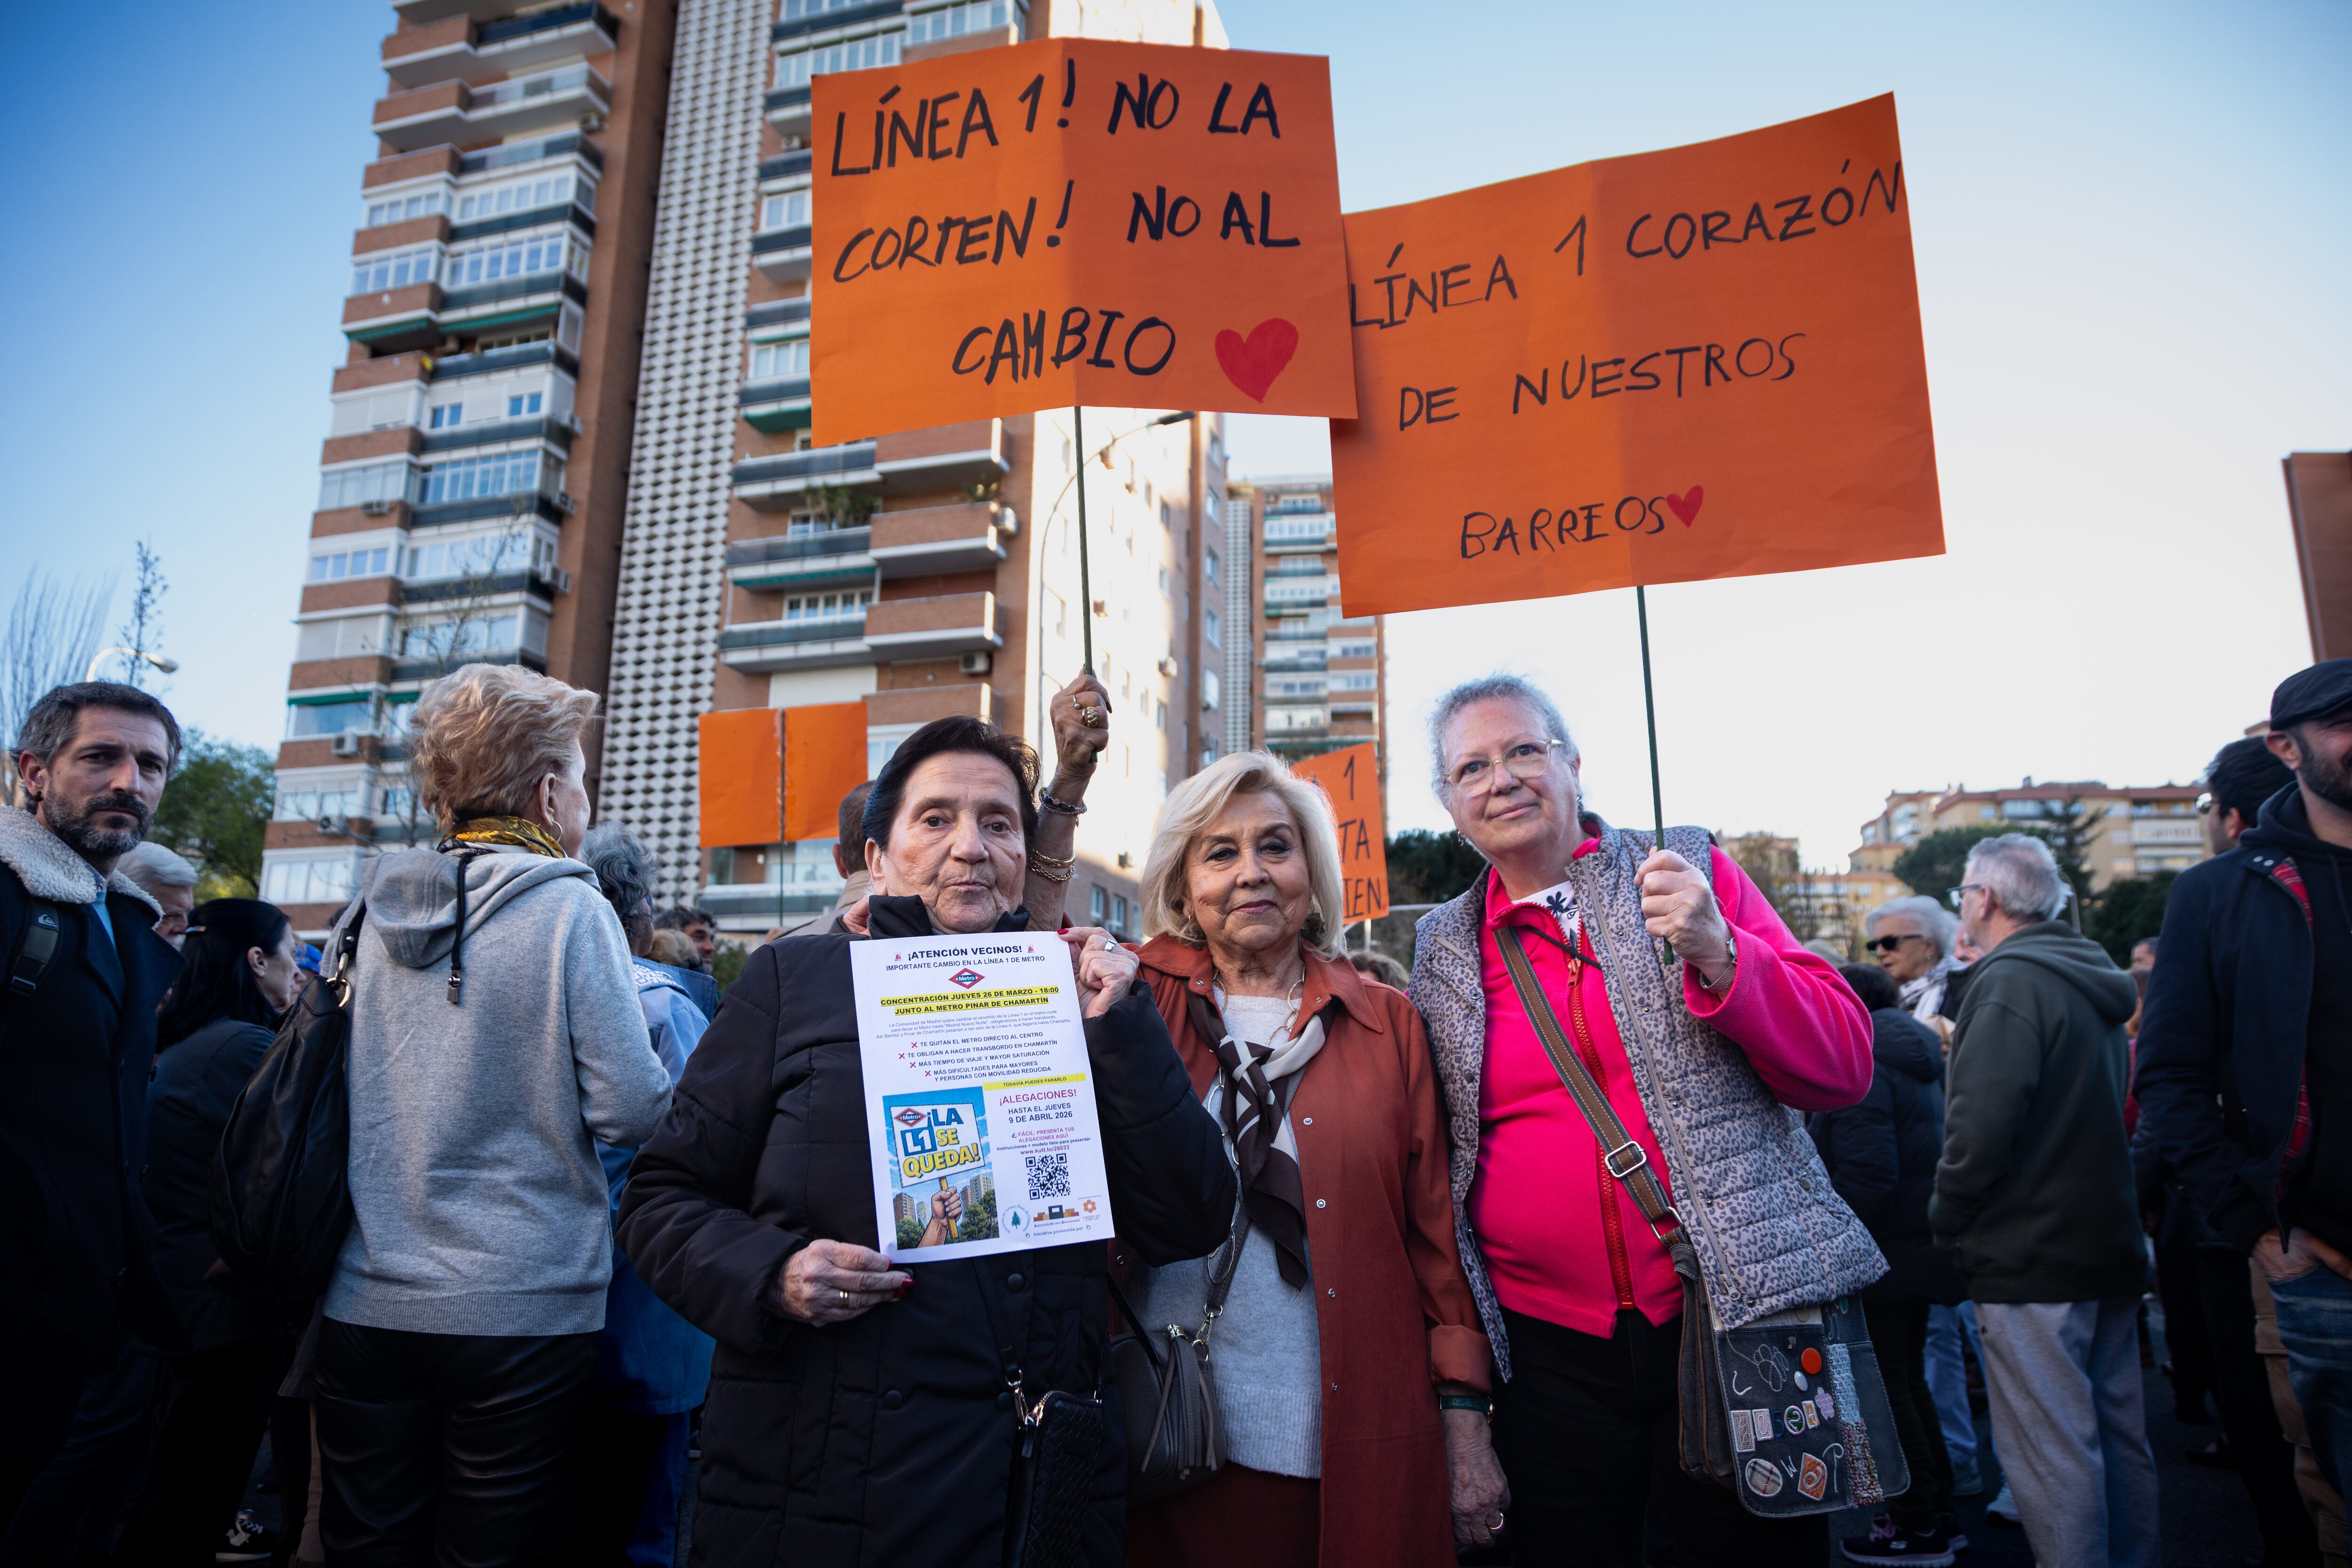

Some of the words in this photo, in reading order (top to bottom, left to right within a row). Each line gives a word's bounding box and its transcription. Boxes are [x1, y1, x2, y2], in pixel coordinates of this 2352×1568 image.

[831, 85, 999, 176] LÍNEA
[1107, 72, 1180, 135] NO
[1208, 81, 1281, 138] LA
[833, 180, 1074, 282] CORTEN!
[1127, 186, 1201, 243] NO
[1221, 191, 1300, 247] AL
[1350, 243, 1518, 329] LÍNEA
[1554, 214, 1586, 276] 1
[1627, 160, 1901, 259] CORAZÓN
[952, 307, 1176, 385] CAMBIO
[1399, 386, 1460, 430] DE
[1513, 333, 1806, 414] NUESTROS
[907, 947, 968, 961] ¡ATENCIÓN
[970, 945, 1022, 955] VECINOS!
[880, 994, 949, 1006] CONCENTRACIÓN
[1003, 996, 1048, 1005] CHAMARTÍN
[948, 1065, 990, 1074] DIFICULTADES
[999, 1089, 1077, 1106] ¡ALEGACIONES!
[1028, 1113, 1053, 1121] ABRIL
[906, 1131, 932, 1153] L1
[937, 1128, 959, 1146] SE
[1020, 1144, 1070, 1155] www.kutt.to/28033
[903, 1143, 981, 1178] QUEDA!
